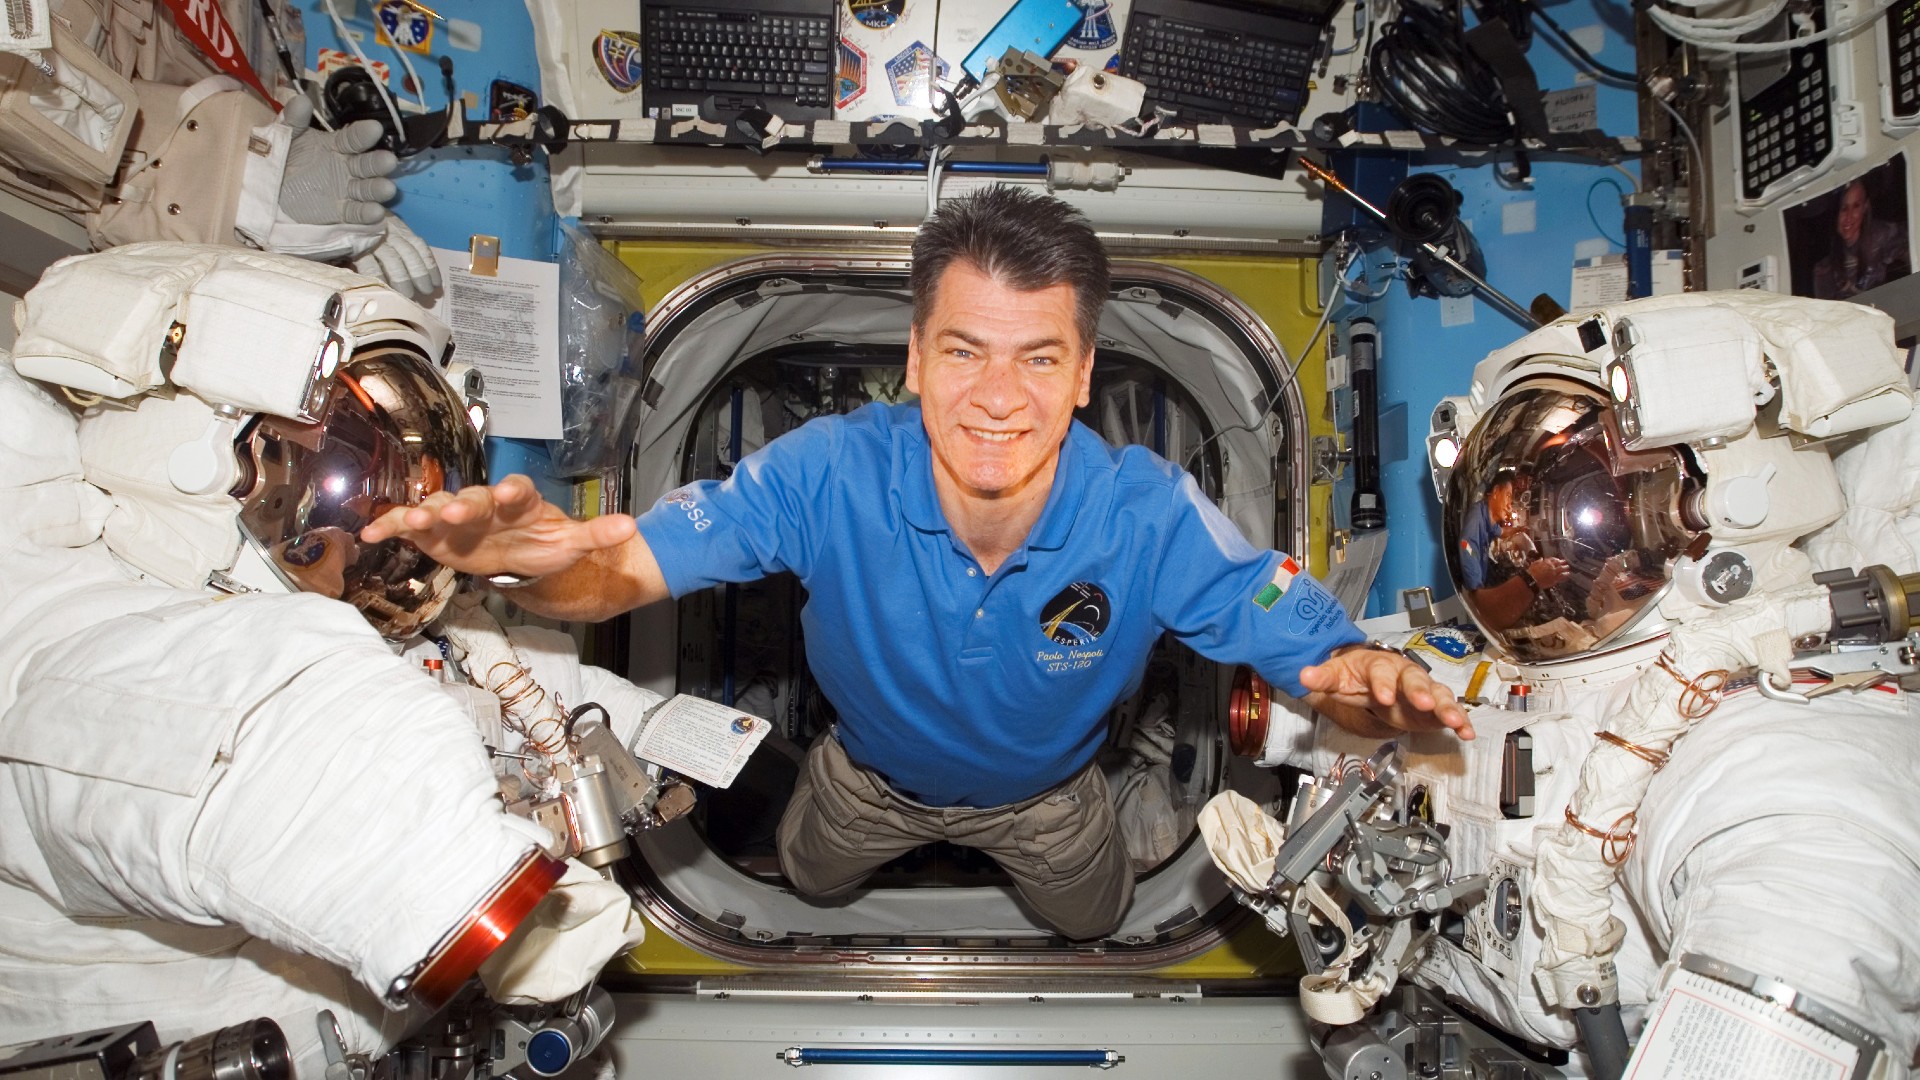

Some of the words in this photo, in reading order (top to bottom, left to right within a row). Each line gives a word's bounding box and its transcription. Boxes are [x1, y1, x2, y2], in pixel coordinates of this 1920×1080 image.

[680, 500, 712, 532] esa
[1308, 613, 1328, 636] agenzia
[1054, 634, 1100, 647] ESPERIA
[1036, 651, 1065, 662] Paolo
[1068, 649, 1104, 660] Nespoli
[1047, 659, 1092, 672] STS-120
